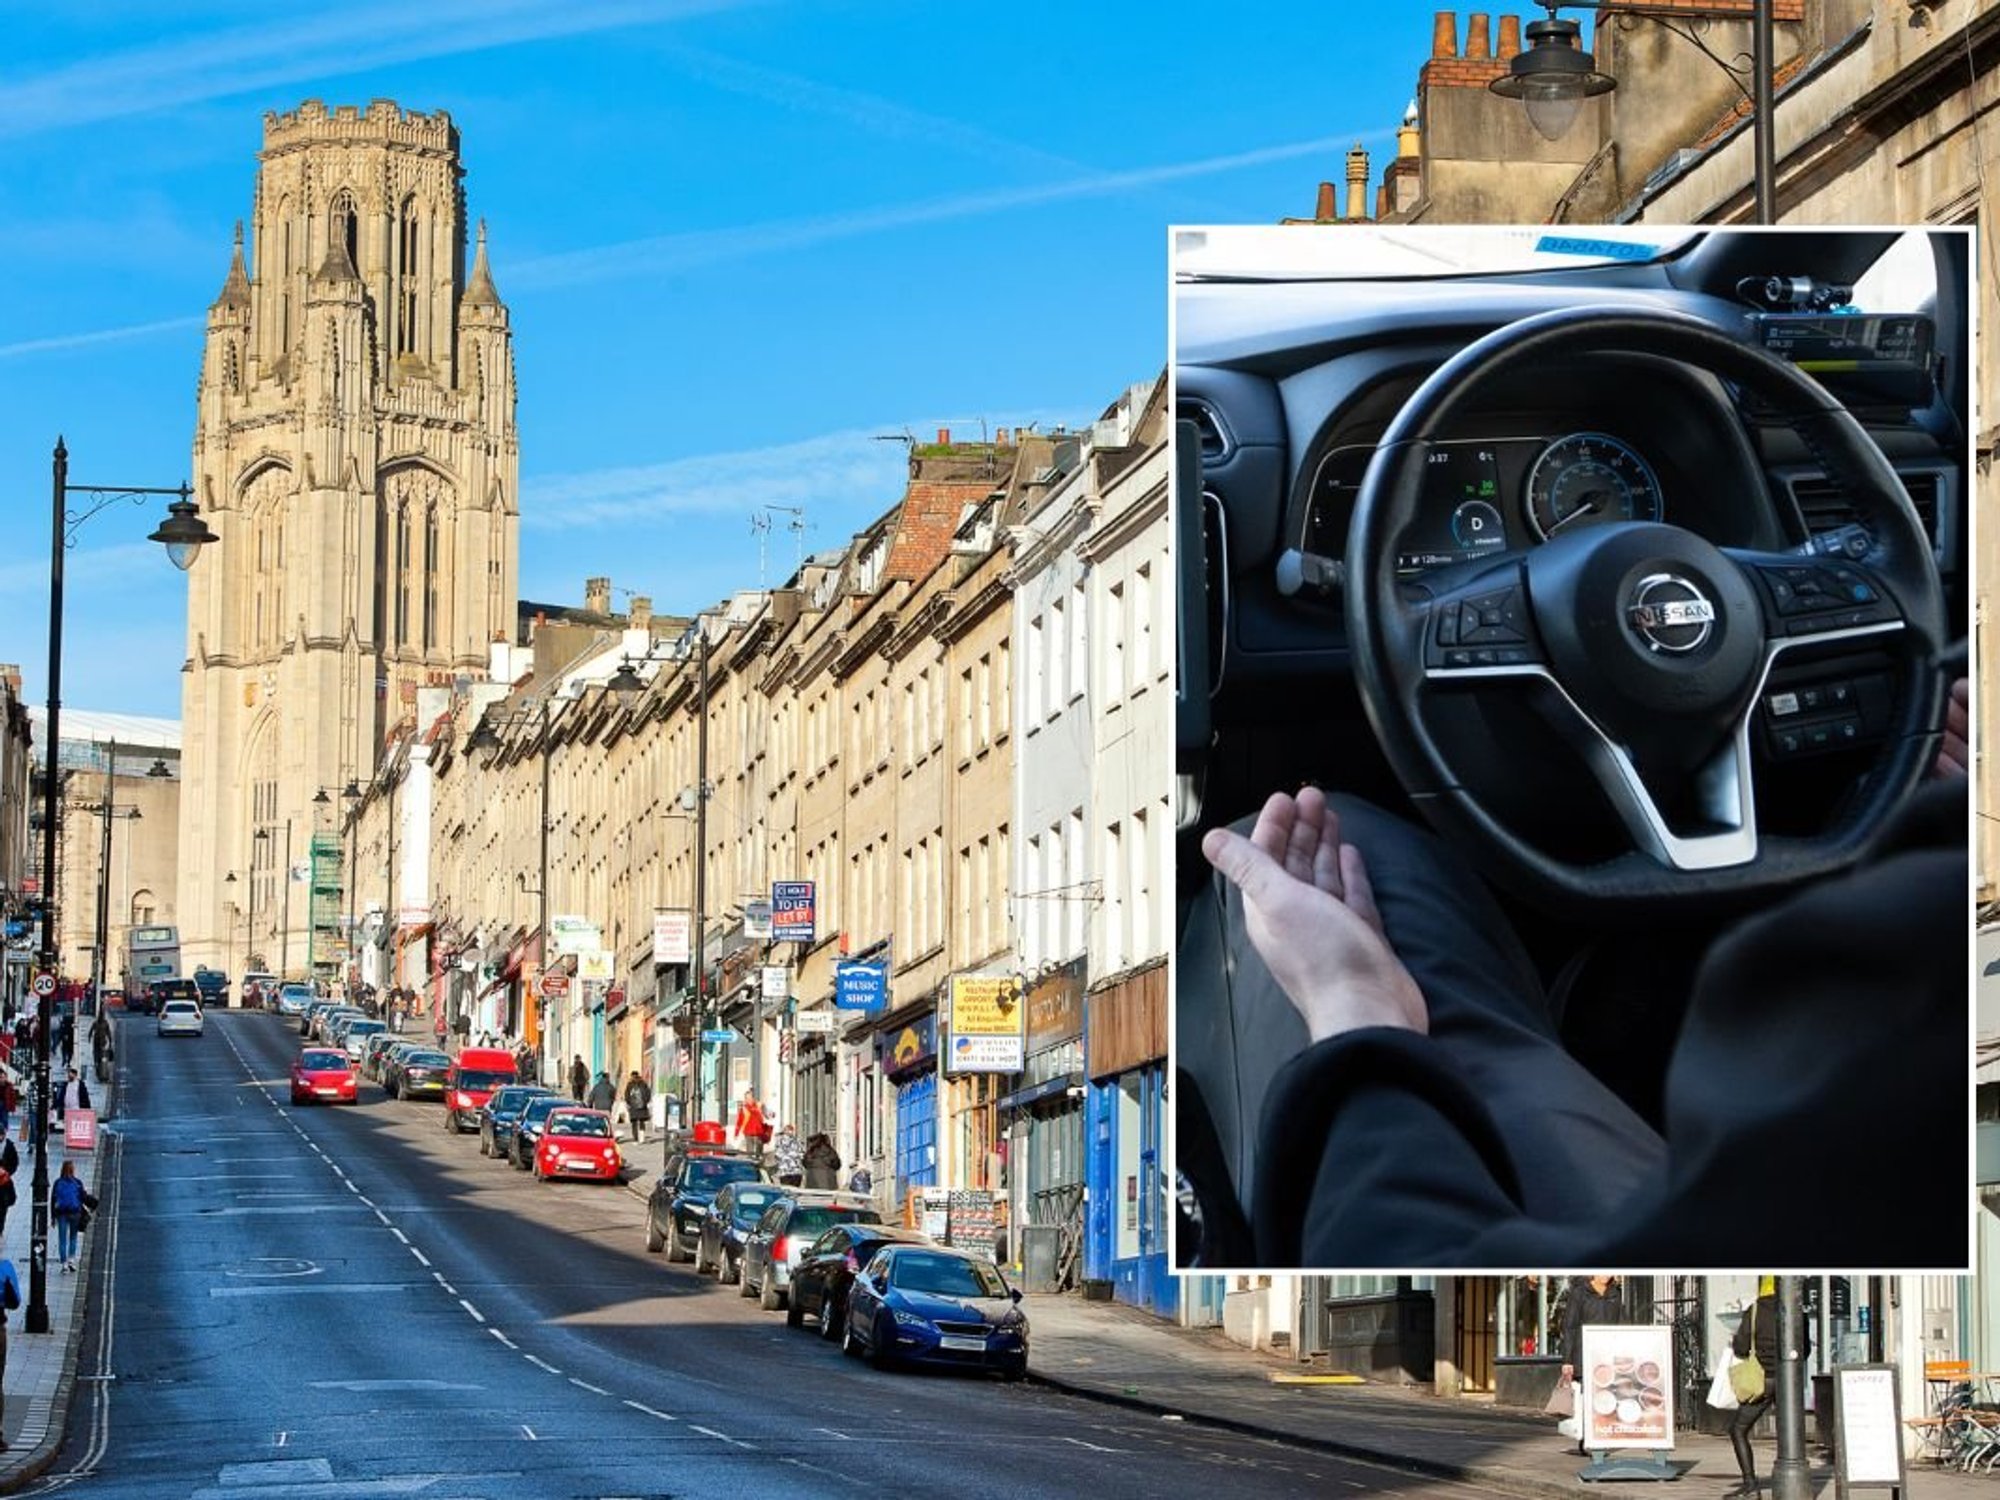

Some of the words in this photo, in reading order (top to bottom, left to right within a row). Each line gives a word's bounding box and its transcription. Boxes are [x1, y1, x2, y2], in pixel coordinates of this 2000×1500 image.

[1471, 517, 1483, 531] D
[1633, 602, 1711, 626] NISSAN
[793, 900, 811, 910] LET
[36, 979, 54, 990] 20
[843, 980, 879, 991] MUSIC
[845, 993, 875, 1003] SHOP
